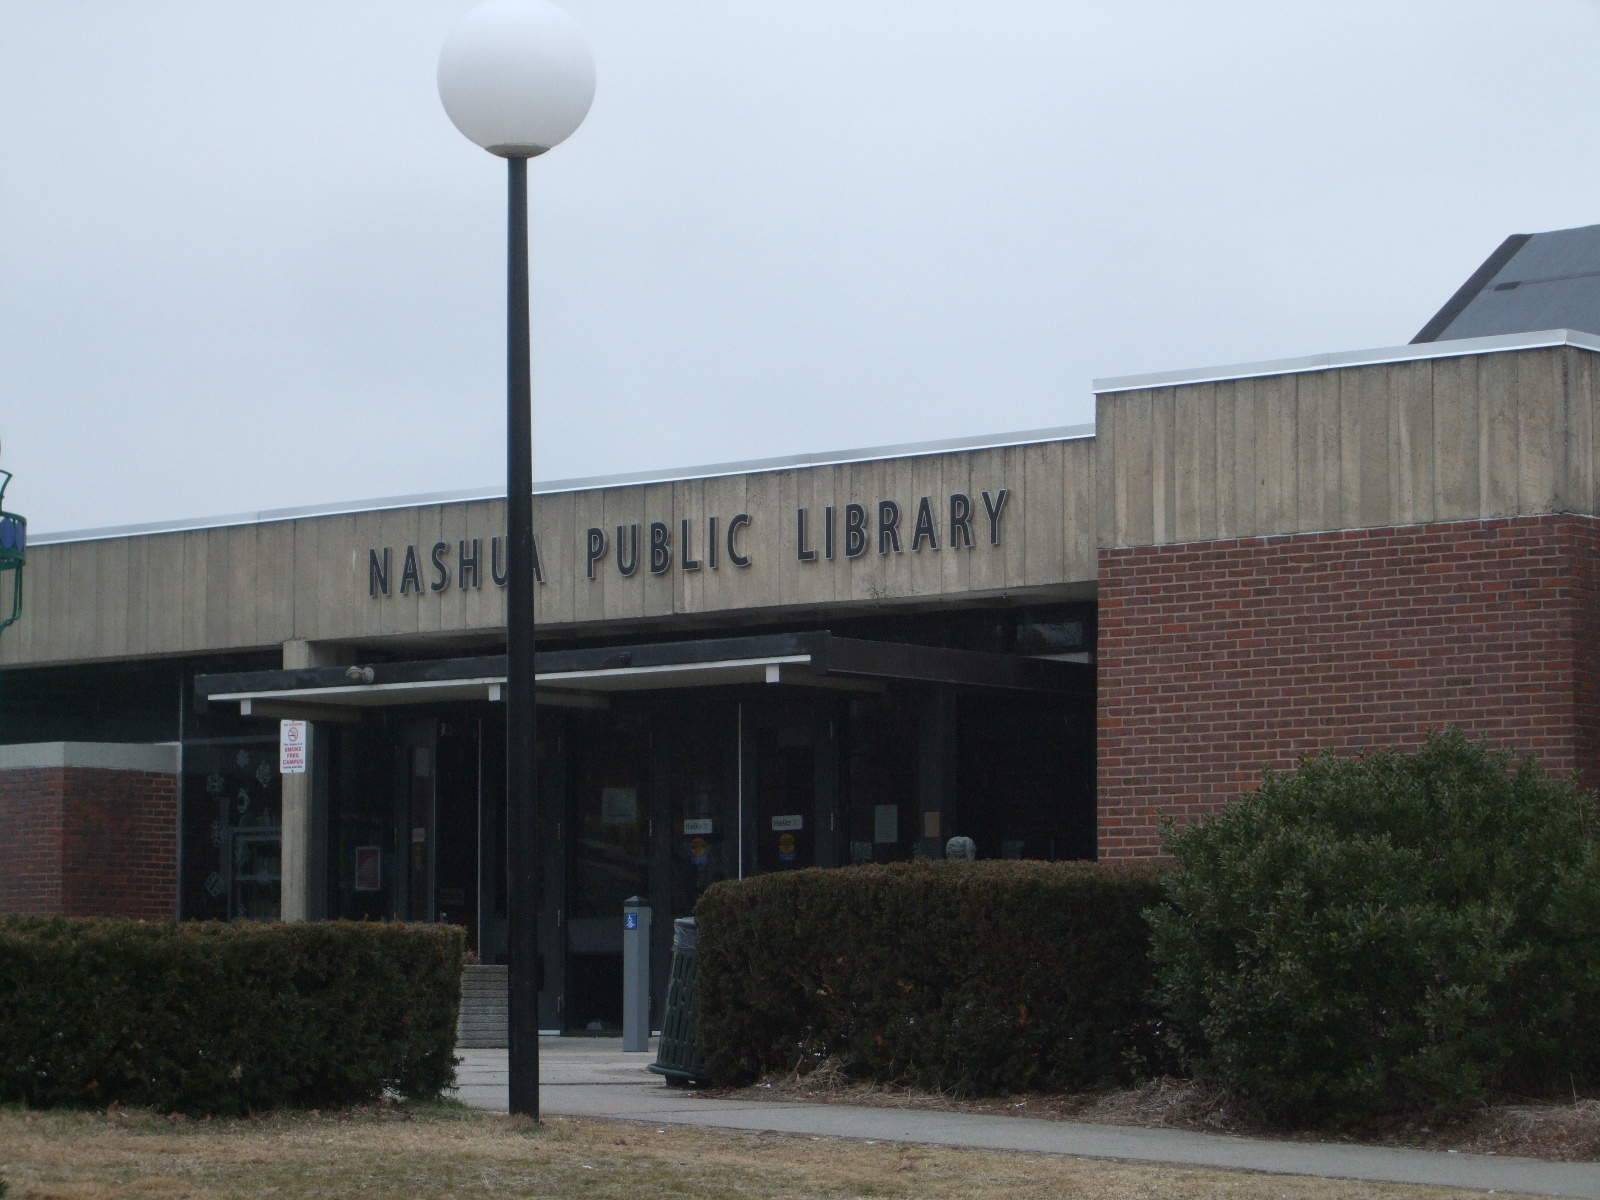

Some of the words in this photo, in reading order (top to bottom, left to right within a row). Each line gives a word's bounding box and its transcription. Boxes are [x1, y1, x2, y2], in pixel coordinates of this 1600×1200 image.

[587, 513, 752, 579] PUBLIC
[797, 488, 1009, 561] LIBRARY
[773, 818, 791, 826] Hello
